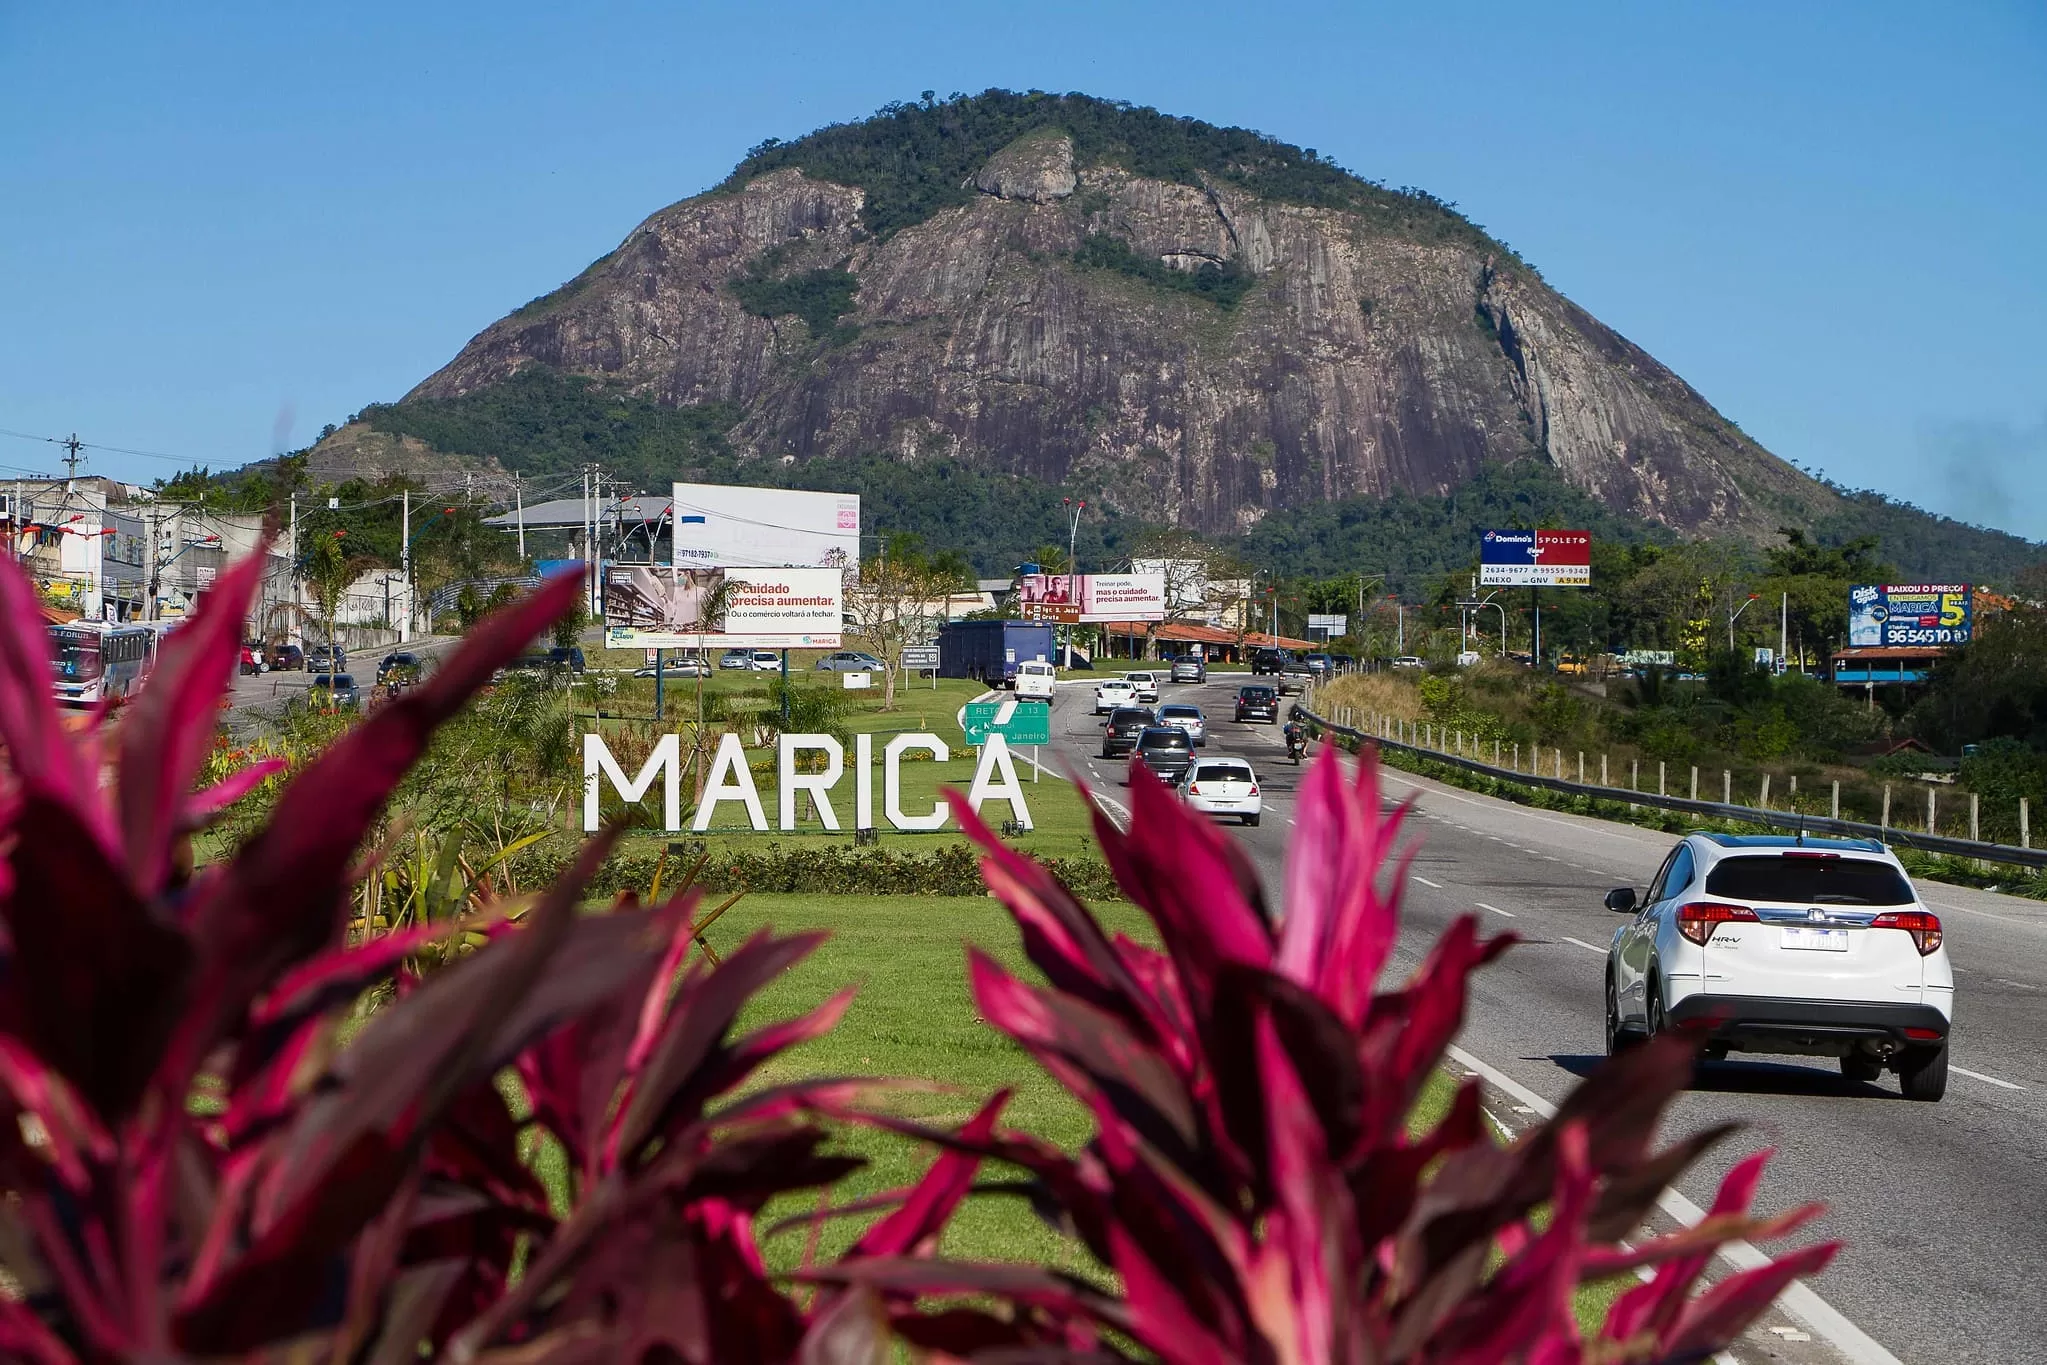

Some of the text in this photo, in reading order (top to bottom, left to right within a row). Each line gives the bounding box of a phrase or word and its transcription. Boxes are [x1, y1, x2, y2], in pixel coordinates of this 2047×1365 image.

[743, 583, 790, 594] cuidado
[1118, 588, 1148, 596] cuidado
[1887, 585, 1921, 593] BAIXOU
[1922, 585, 1930, 593] O
[1853, 586, 1877, 600] Disk
[731, 595, 835, 608] precisa aumentar.
[731, 610, 742, 618] Ou
[748, 610, 781, 618] comércio
[781, 610, 806, 618] voltará
[812, 610, 836, 618] fechar.
[1028, 707, 1038, 715] 13
[1011, 732, 1046, 740] Janeiro
[583, 701, 1033, 832] MARICÁ
[1711, 936, 1741, 944] HR-V
